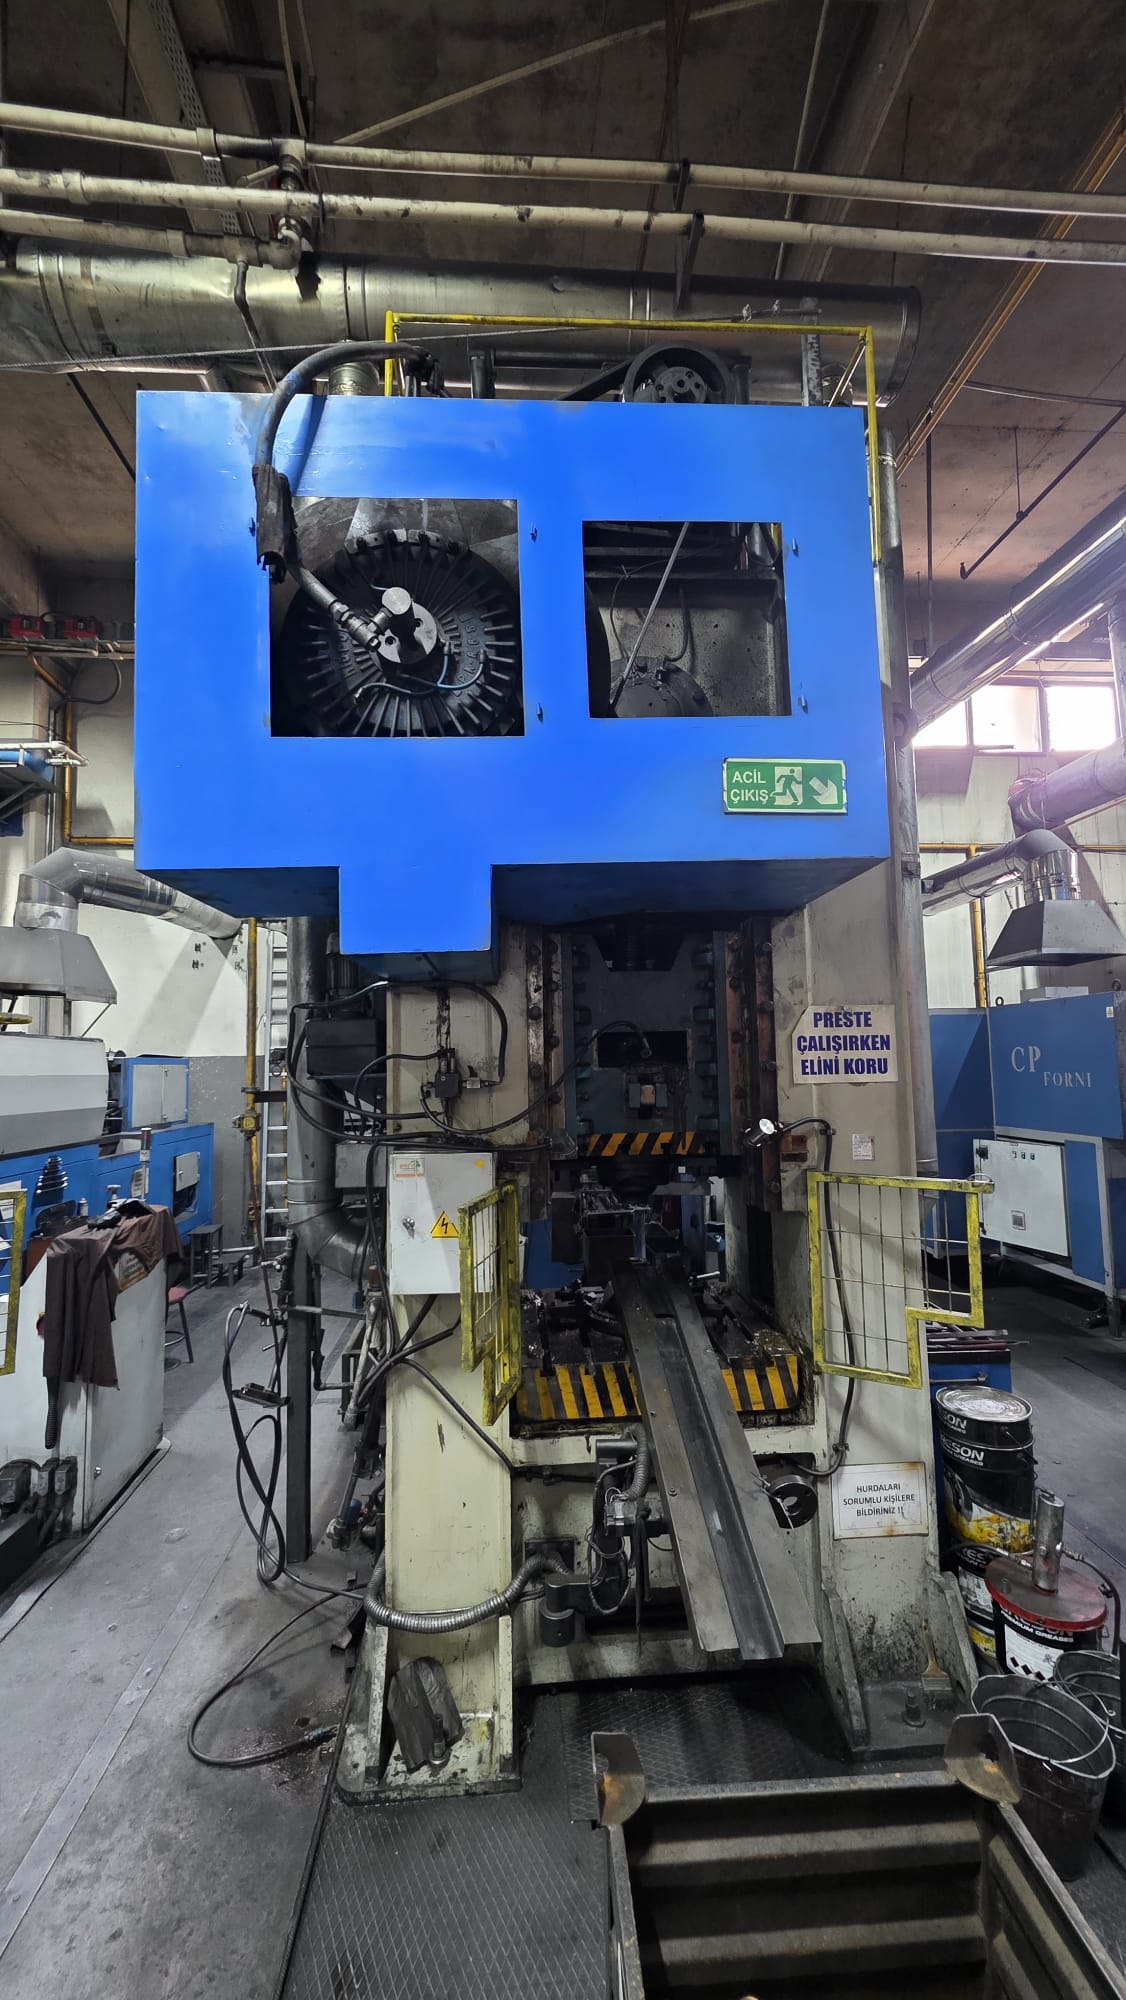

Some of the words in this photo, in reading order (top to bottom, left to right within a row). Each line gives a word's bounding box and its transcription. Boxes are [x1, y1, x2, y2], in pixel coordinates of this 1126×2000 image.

[732, 769, 766, 784] ACİL
[730, 789, 769, 804] ÇIKIŞ
[813, 1011, 872, 1028] PRESTE
[797, 1034, 891, 1055] ÇALIŞIRKEN
[801, 1055, 840, 1076] ELİNİ
[844, 1058, 888, 1075] KORU
[1011, 1045, 1041, 1072] CP
[1043, 1071, 1092, 1088] FORNI
[856, 1483, 901, 1493] HURDALARI
[843, 1496, 882, 1506] SORUMLU
[883, 1494, 915, 1504] KİŞİLERE
[856, 1506, 895, 1517] BİLDİRİNİZ
[1001, 1610, 1034, 1634] PREMIUM
[1034, 1629, 1074, 1643] GREASES
